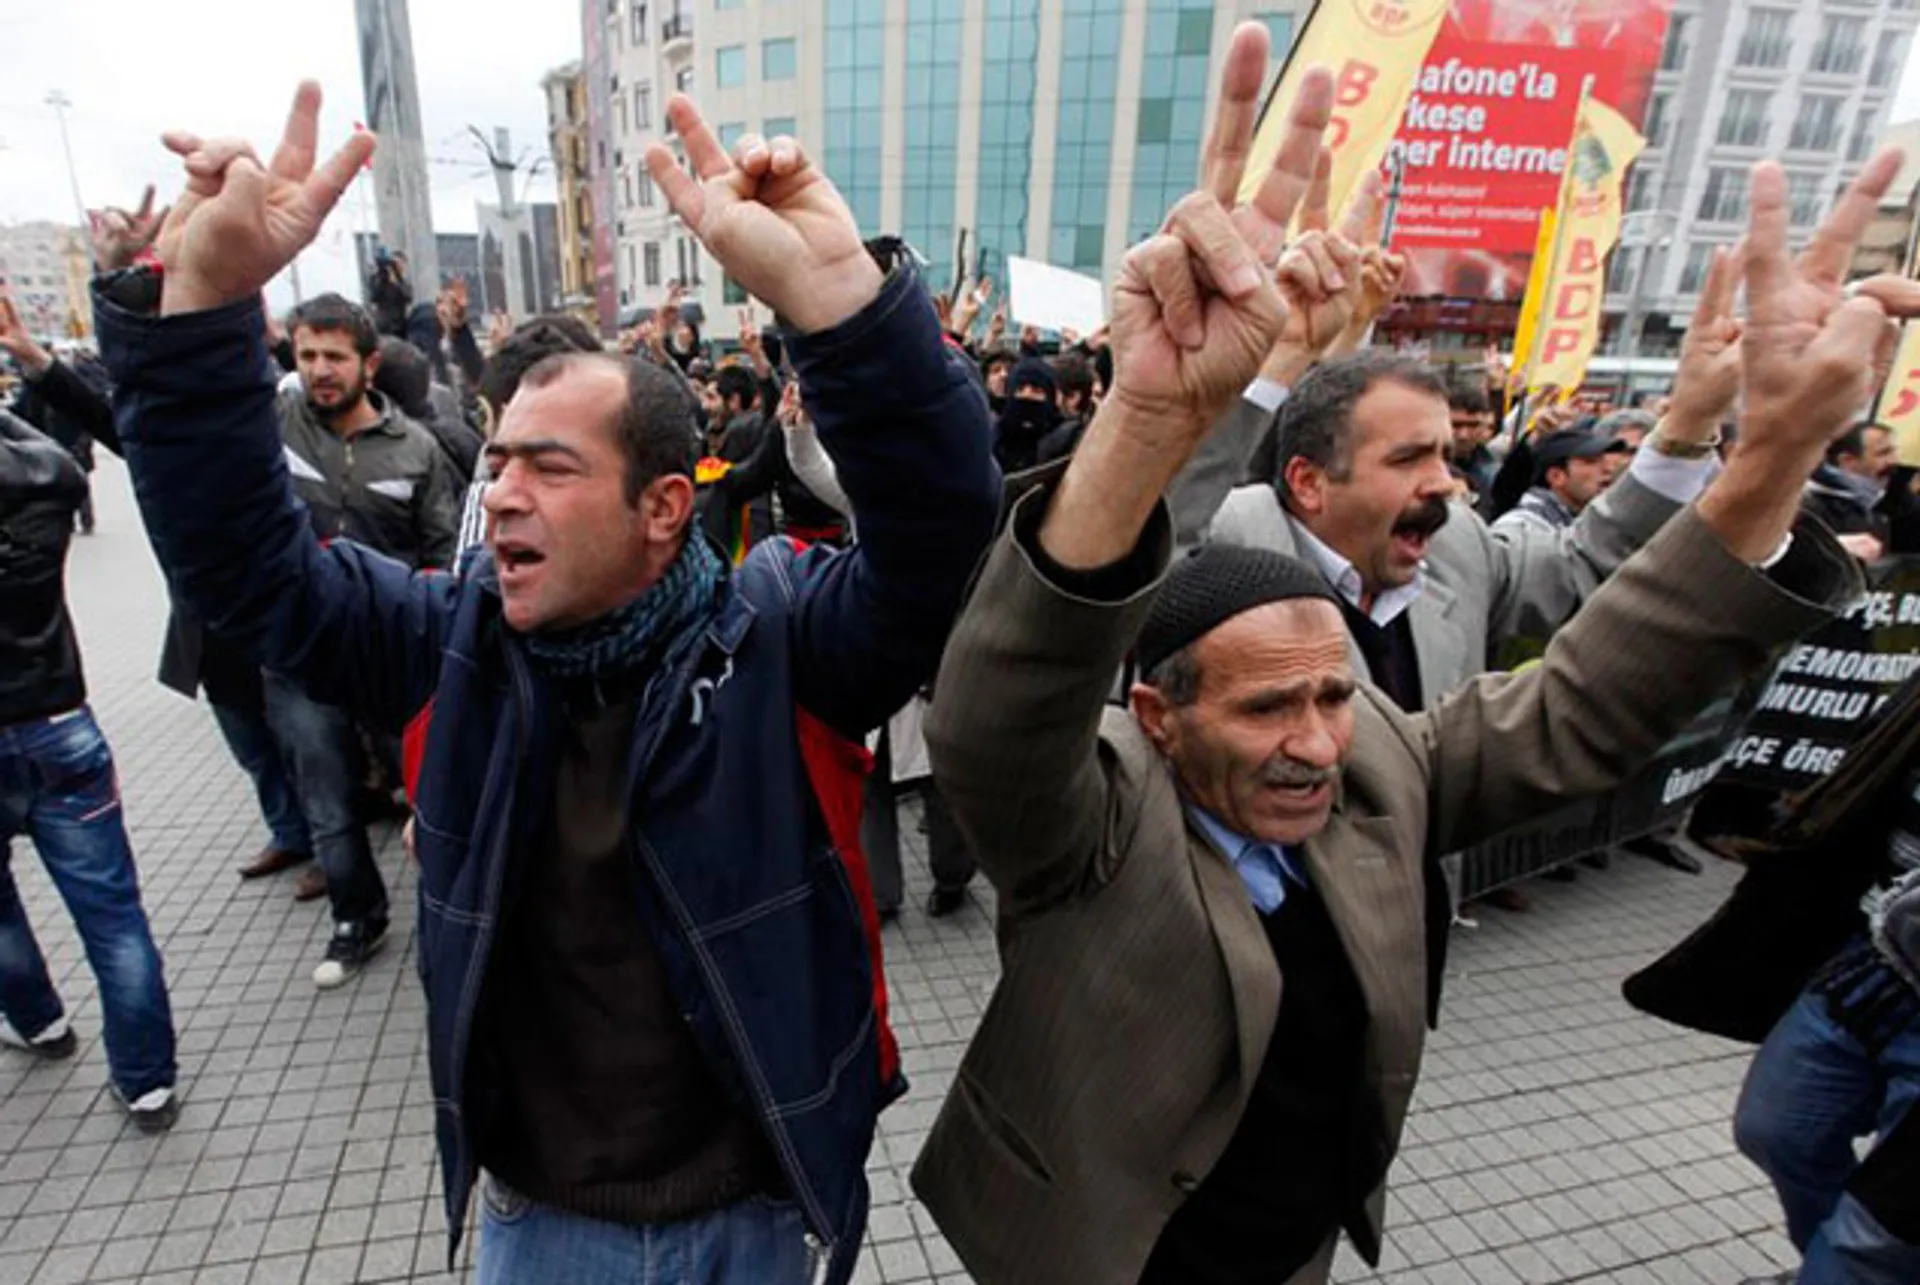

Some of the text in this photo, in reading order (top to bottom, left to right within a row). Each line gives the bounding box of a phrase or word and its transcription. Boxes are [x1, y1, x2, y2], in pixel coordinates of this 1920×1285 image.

[1406, 94, 1486, 132] kese
[1386, 134, 1567, 173] per interne
[1757, 682, 1870, 721] NURLU
